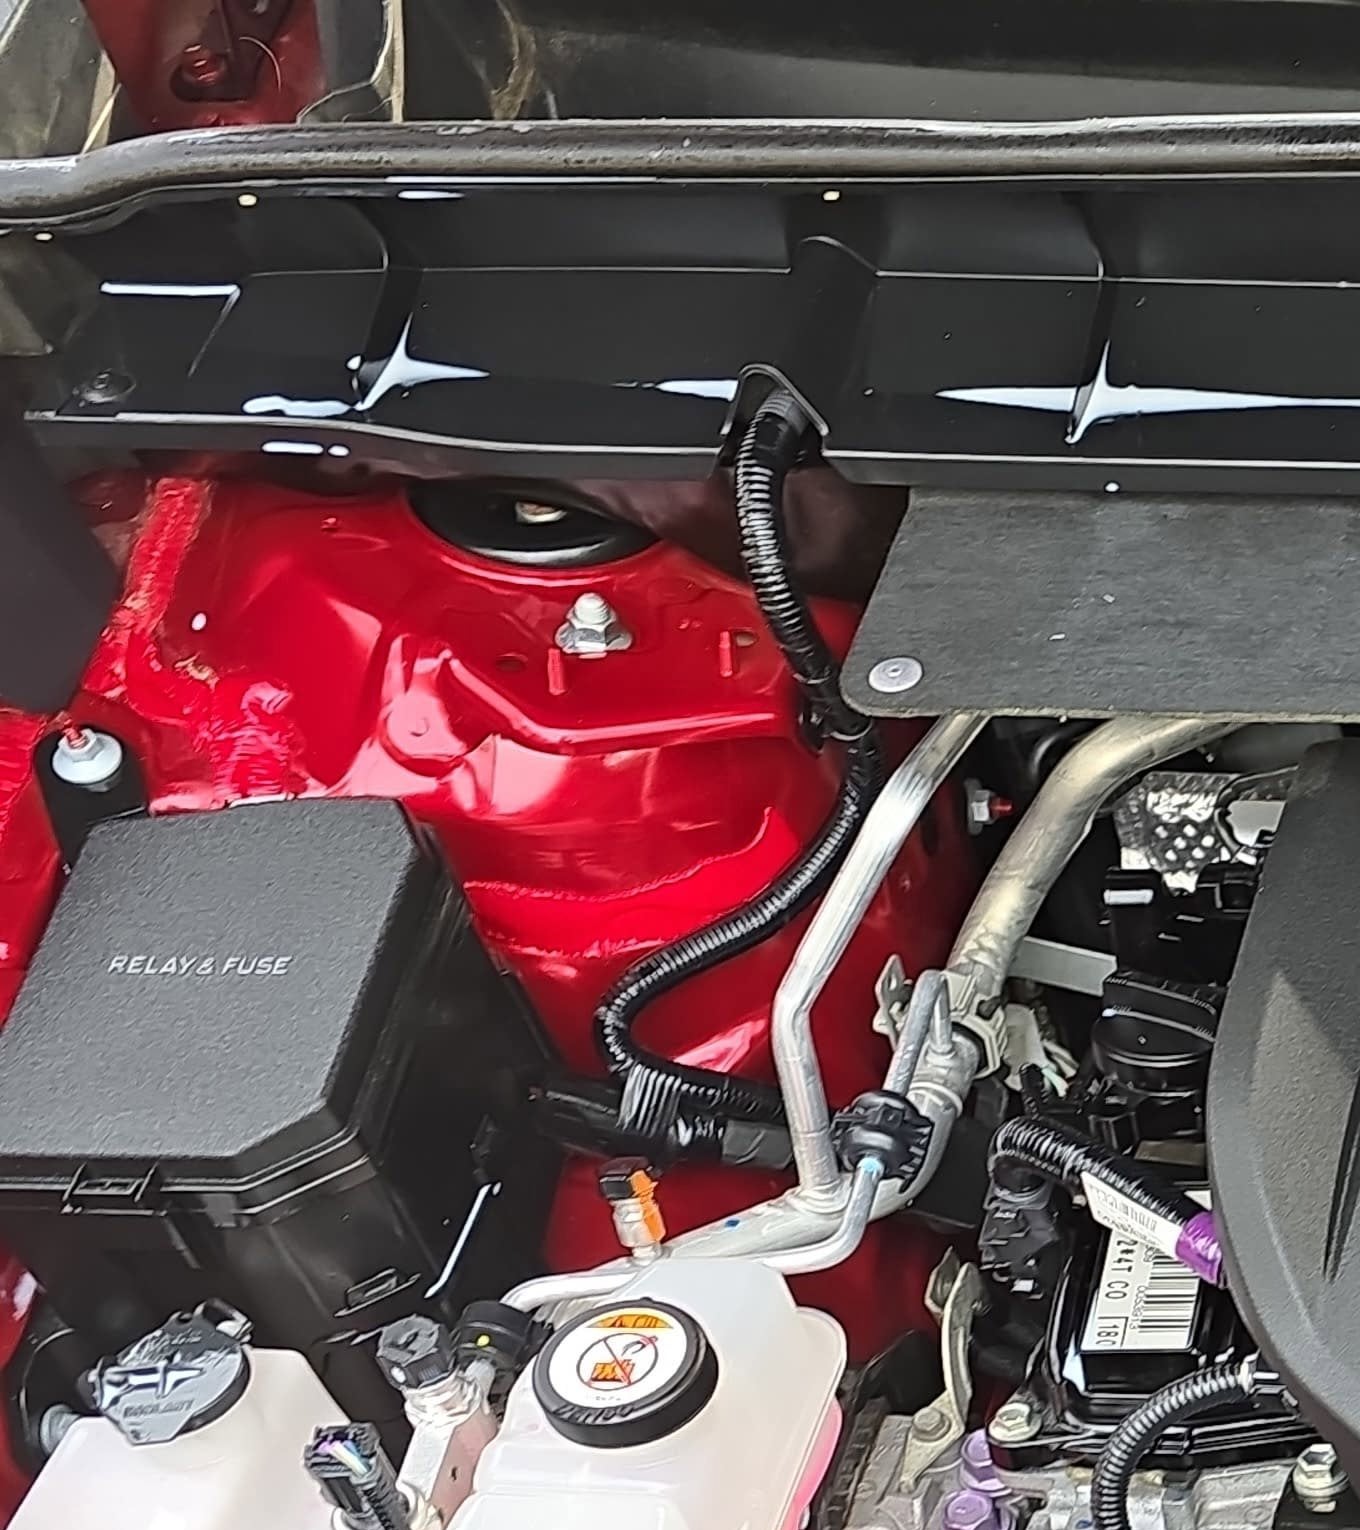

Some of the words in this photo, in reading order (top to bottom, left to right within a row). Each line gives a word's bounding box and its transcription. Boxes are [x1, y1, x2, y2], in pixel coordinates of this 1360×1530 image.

[108, 956, 197, 975] RELAY
[196, 957, 214, 975] &
[221, 956, 292, 975] FUSE
